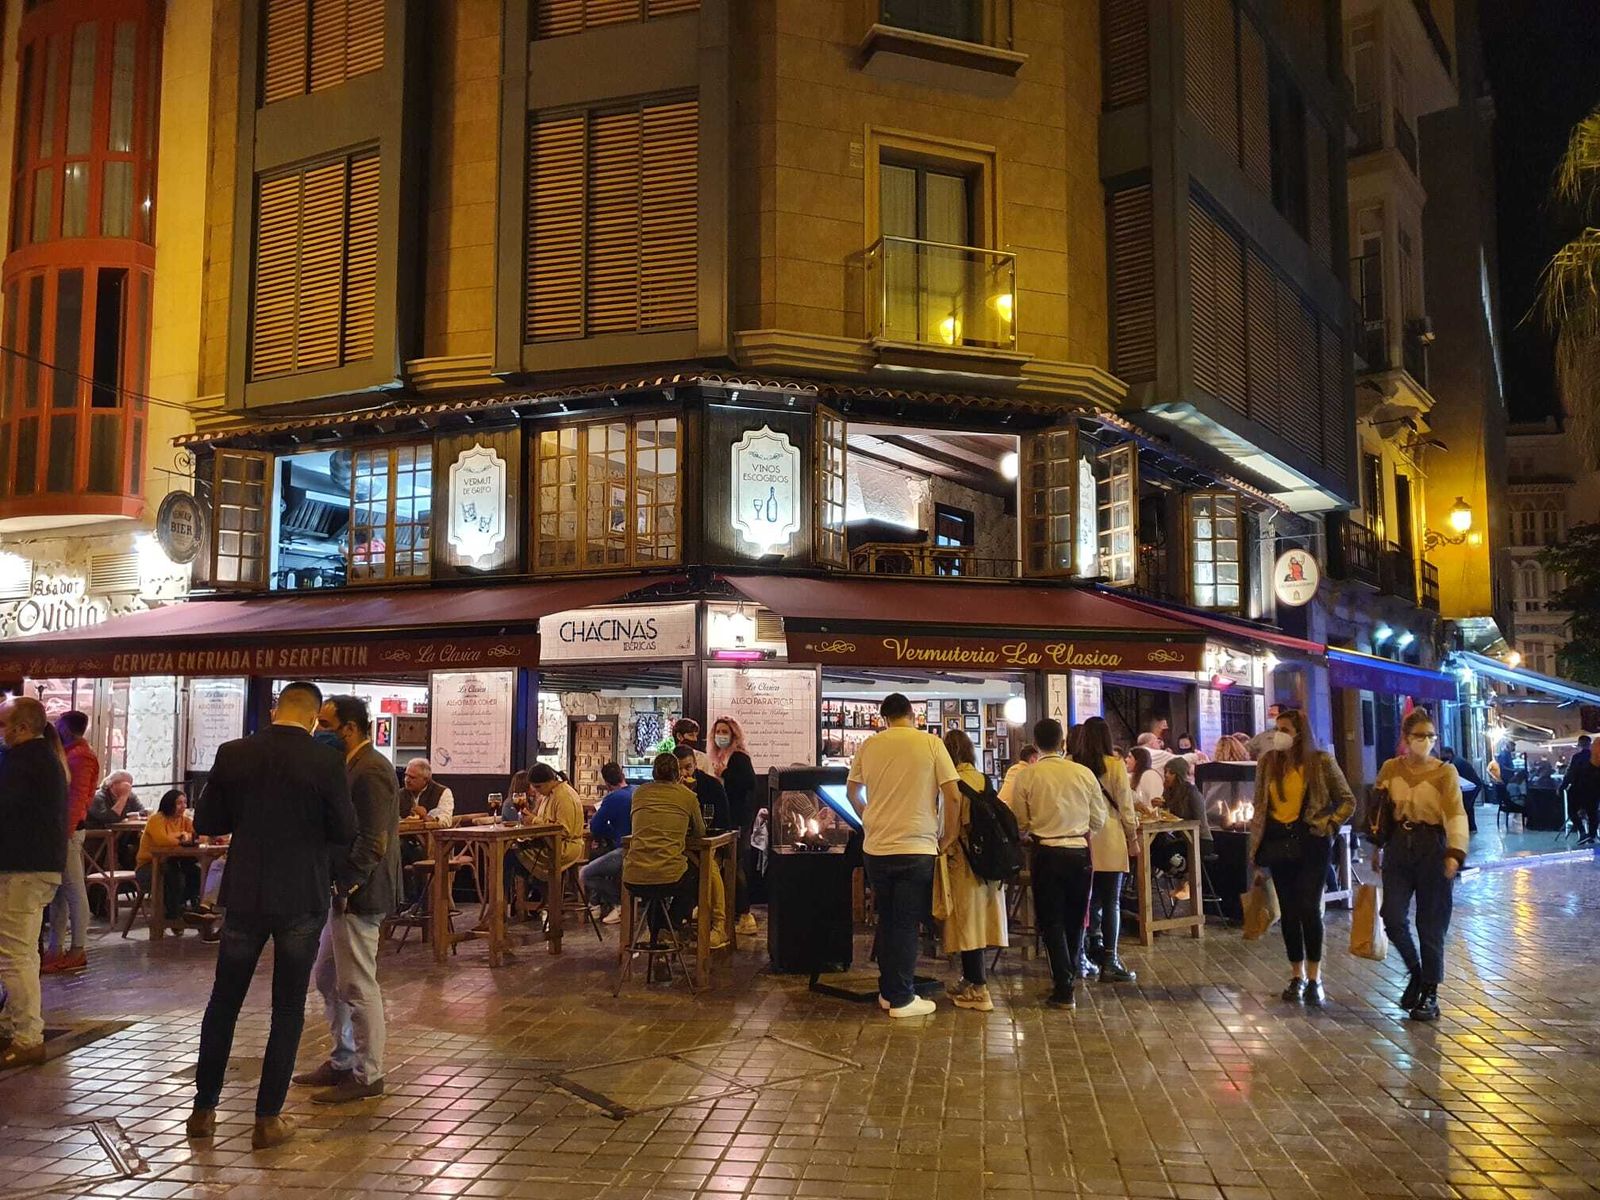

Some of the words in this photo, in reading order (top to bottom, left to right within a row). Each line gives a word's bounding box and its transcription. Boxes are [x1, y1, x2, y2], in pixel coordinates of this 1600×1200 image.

[752, 463, 780, 473] VINOS
[463, 477, 491, 486] VERMUT
[743, 473, 789, 484] ESCOGIDOS
[471, 486, 491, 494] GRIFO
[171, 521, 192, 535] BIER
[34, 578, 79, 596] Asador
[17, 600, 97, 631] Ovidio
[559, 617, 658, 643] CHACINAS
[113, 653, 174, 671] CERVEZA
[178, 651, 250, 670] ENFRIADA
[255, 650, 275, 668] EN
[278, 646, 368, 667] SERPENTIN
[414, 644, 436, 663] La
[439, 644, 481, 662] Clasica
[883, 637, 999, 664] Vermuteria
[1002, 642, 1041, 665] La
[1045, 642, 1122, 666] Clasica
